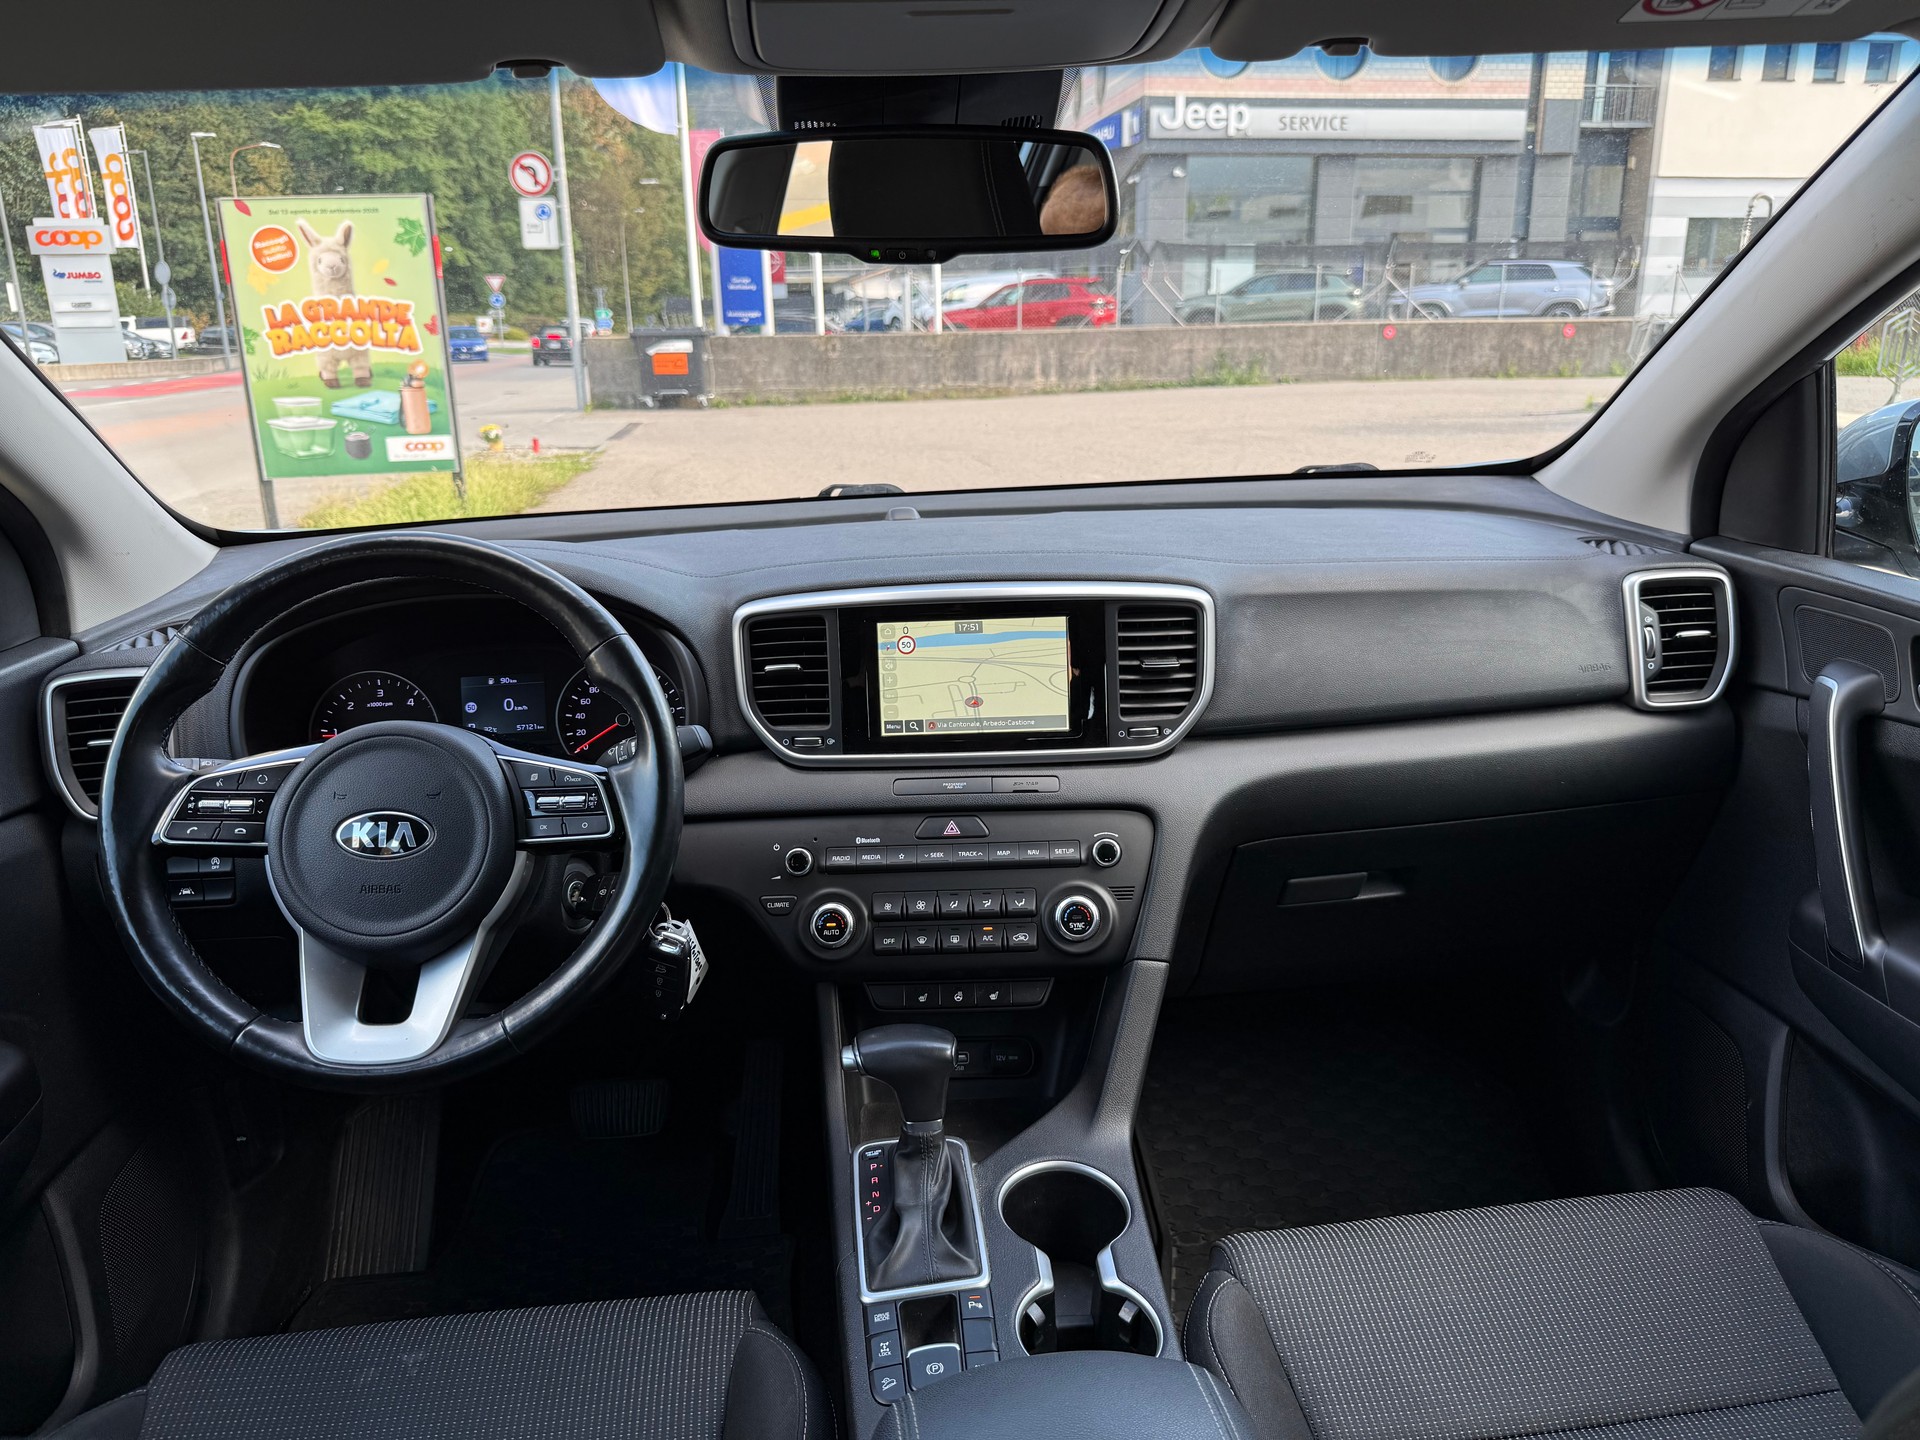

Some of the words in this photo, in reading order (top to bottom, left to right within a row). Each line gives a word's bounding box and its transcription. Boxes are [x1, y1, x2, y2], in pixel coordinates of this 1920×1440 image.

[1159, 95, 1249, 137] Jeep
[1278, 115, 1349, 132] SERVICE
[35, 230, 103, 249] coop
[66, 271, 101, 279] JUMBO
[264, 302, 301, 330] LA
[301, 298, 412, 327] GRANDE
[267, 319, 420, 356] RACCOLTA
[902, 627, 909, 635] 0
[958, 624, 979, 632] 17:51
[377, 689, 384, 697] 3
[347, 702, 354, 710] 2
[406, 698, 414, 706] 4
[504, 698, 514, 711] 0
[949, 720, 981, 729] Cantonale,
[351, 821, 417, 848] KIA
[360, 884, 402, 894] AIRBAG
